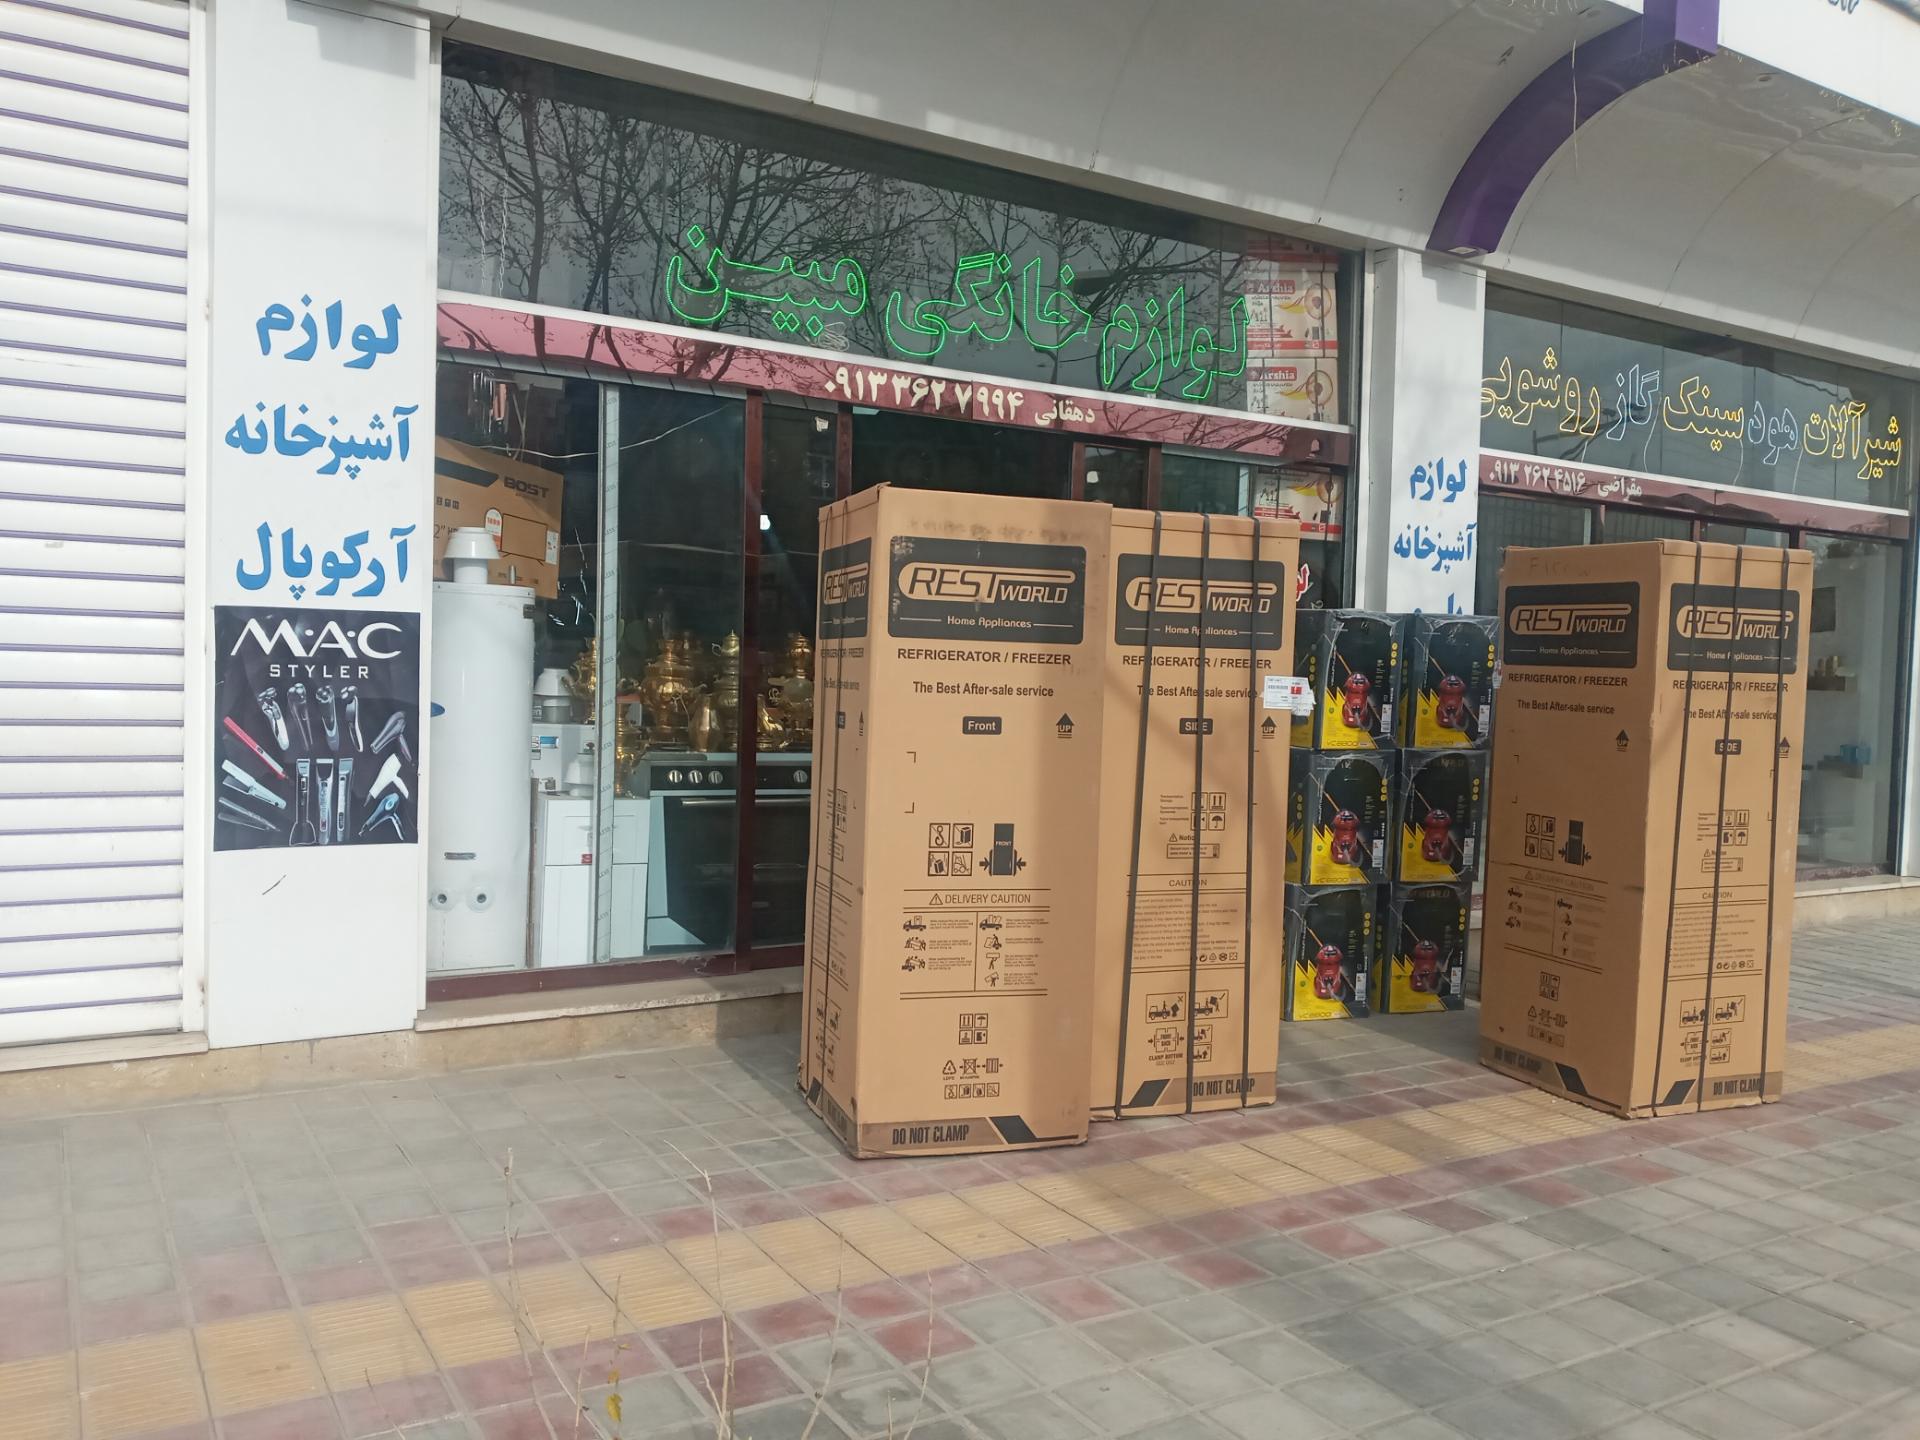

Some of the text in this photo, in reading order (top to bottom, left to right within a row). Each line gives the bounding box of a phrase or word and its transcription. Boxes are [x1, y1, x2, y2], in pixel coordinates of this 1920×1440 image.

[666, 224, 1249, 398] لوازم خانگی مبین
[256, 294, 402, 369] لوازم
[1260, 369, 1295, 380] Arshia
[1606, 364, 1660, 440] گاز
[1034, 399, 1096, 427] دهقانی
[1663, 376, 1743, 452] سینک
[225, 401, 419, 480] آشپزخانه
[1748, 401, 1798, 465] هود
[503, 476, 550, 498] BOST
[1410, 456, 1468, 503] لوازم
[1393, 522, 1478, 574] آشپزخانه
[236, 521, 416, 600] آرکوپال
[906, 565, 1068, 604] REST WORLD
[947, 615, 1032, 628] Home Appliances
[1514, 607, 1626, 634] REST WORLD
[1165, 624, 1189, 634] Home
[897, 648, 1071, 665] REFRIGERATOR / FREEZER
[1561, 647, 1599, 655] Appliances
[1706, 651, 1725, 659] Home
[269, 664, 369, 679] STYLER
[1508, 673, 1576, 685] REFRIGERATOR
[1583, 675, 1628, 687] FREEZER
[913, 681, 1054, 696] The Best After-sale service
[1156, 685, 1178, 696] Best
[1518, 699, 1615, 714] The Best After-sale service
[1698, 709, 1714, 719] Best
[1752, 710, 1777, 720] service
[968, 720, 996, 731] Front
[1058, 724, 1071, 732] UP
[944, 893, 1031, 904] DELIVERY CAUTION
[1193, 1081, 1205, 1096] DO
[1206, 1080, 1223, 1096] NOT
[1713, 1081, 1723, 1095] DO
[1724, 1080, 1738, 1094] NOT
[892, 1124, 969, 1145] DO NOT CLAMP
